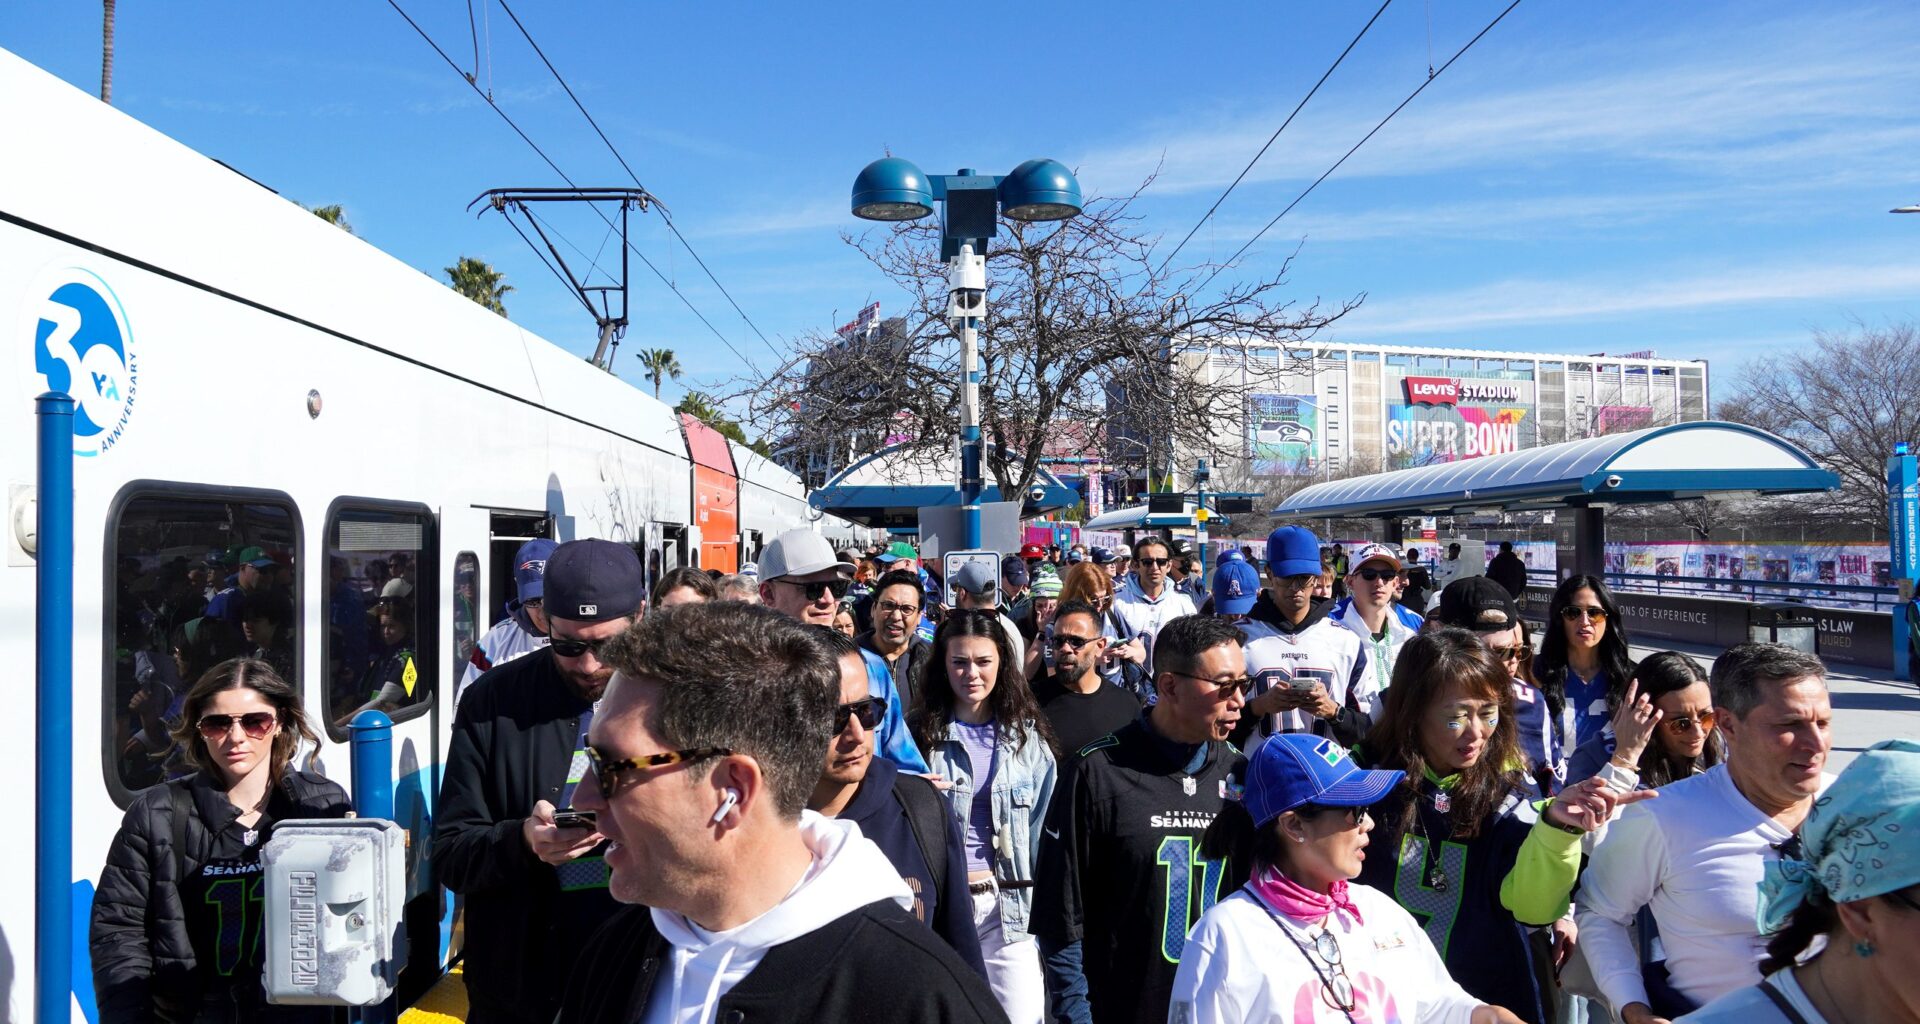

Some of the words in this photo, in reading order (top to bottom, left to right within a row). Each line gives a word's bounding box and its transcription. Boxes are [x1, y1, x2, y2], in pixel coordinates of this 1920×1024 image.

[1463, 385, 1520, 399] STADIUM
[101, 352, 137, 453] ANNIVERSARY
[1388, 419, 1458, 455] SUPER
[1091, 473, 1099, 517] AFE
[1907, 501, 1917, 570] EMERGENCY
[1619, 605, 1636, 616] ONS
[1638, 606, 1649, 617] OF
[1652, 608, 1707, 624] EXPERIENCE
[1830, 619, 1854, 634] LAW
[1281, 652, 1308, 660] PATRIOTS
[1150, 814, 1213, 829] SEAHAW
[203, 864, 264, 876] SEAHAW
[289, 871, 318, 986] TELEPHONE
